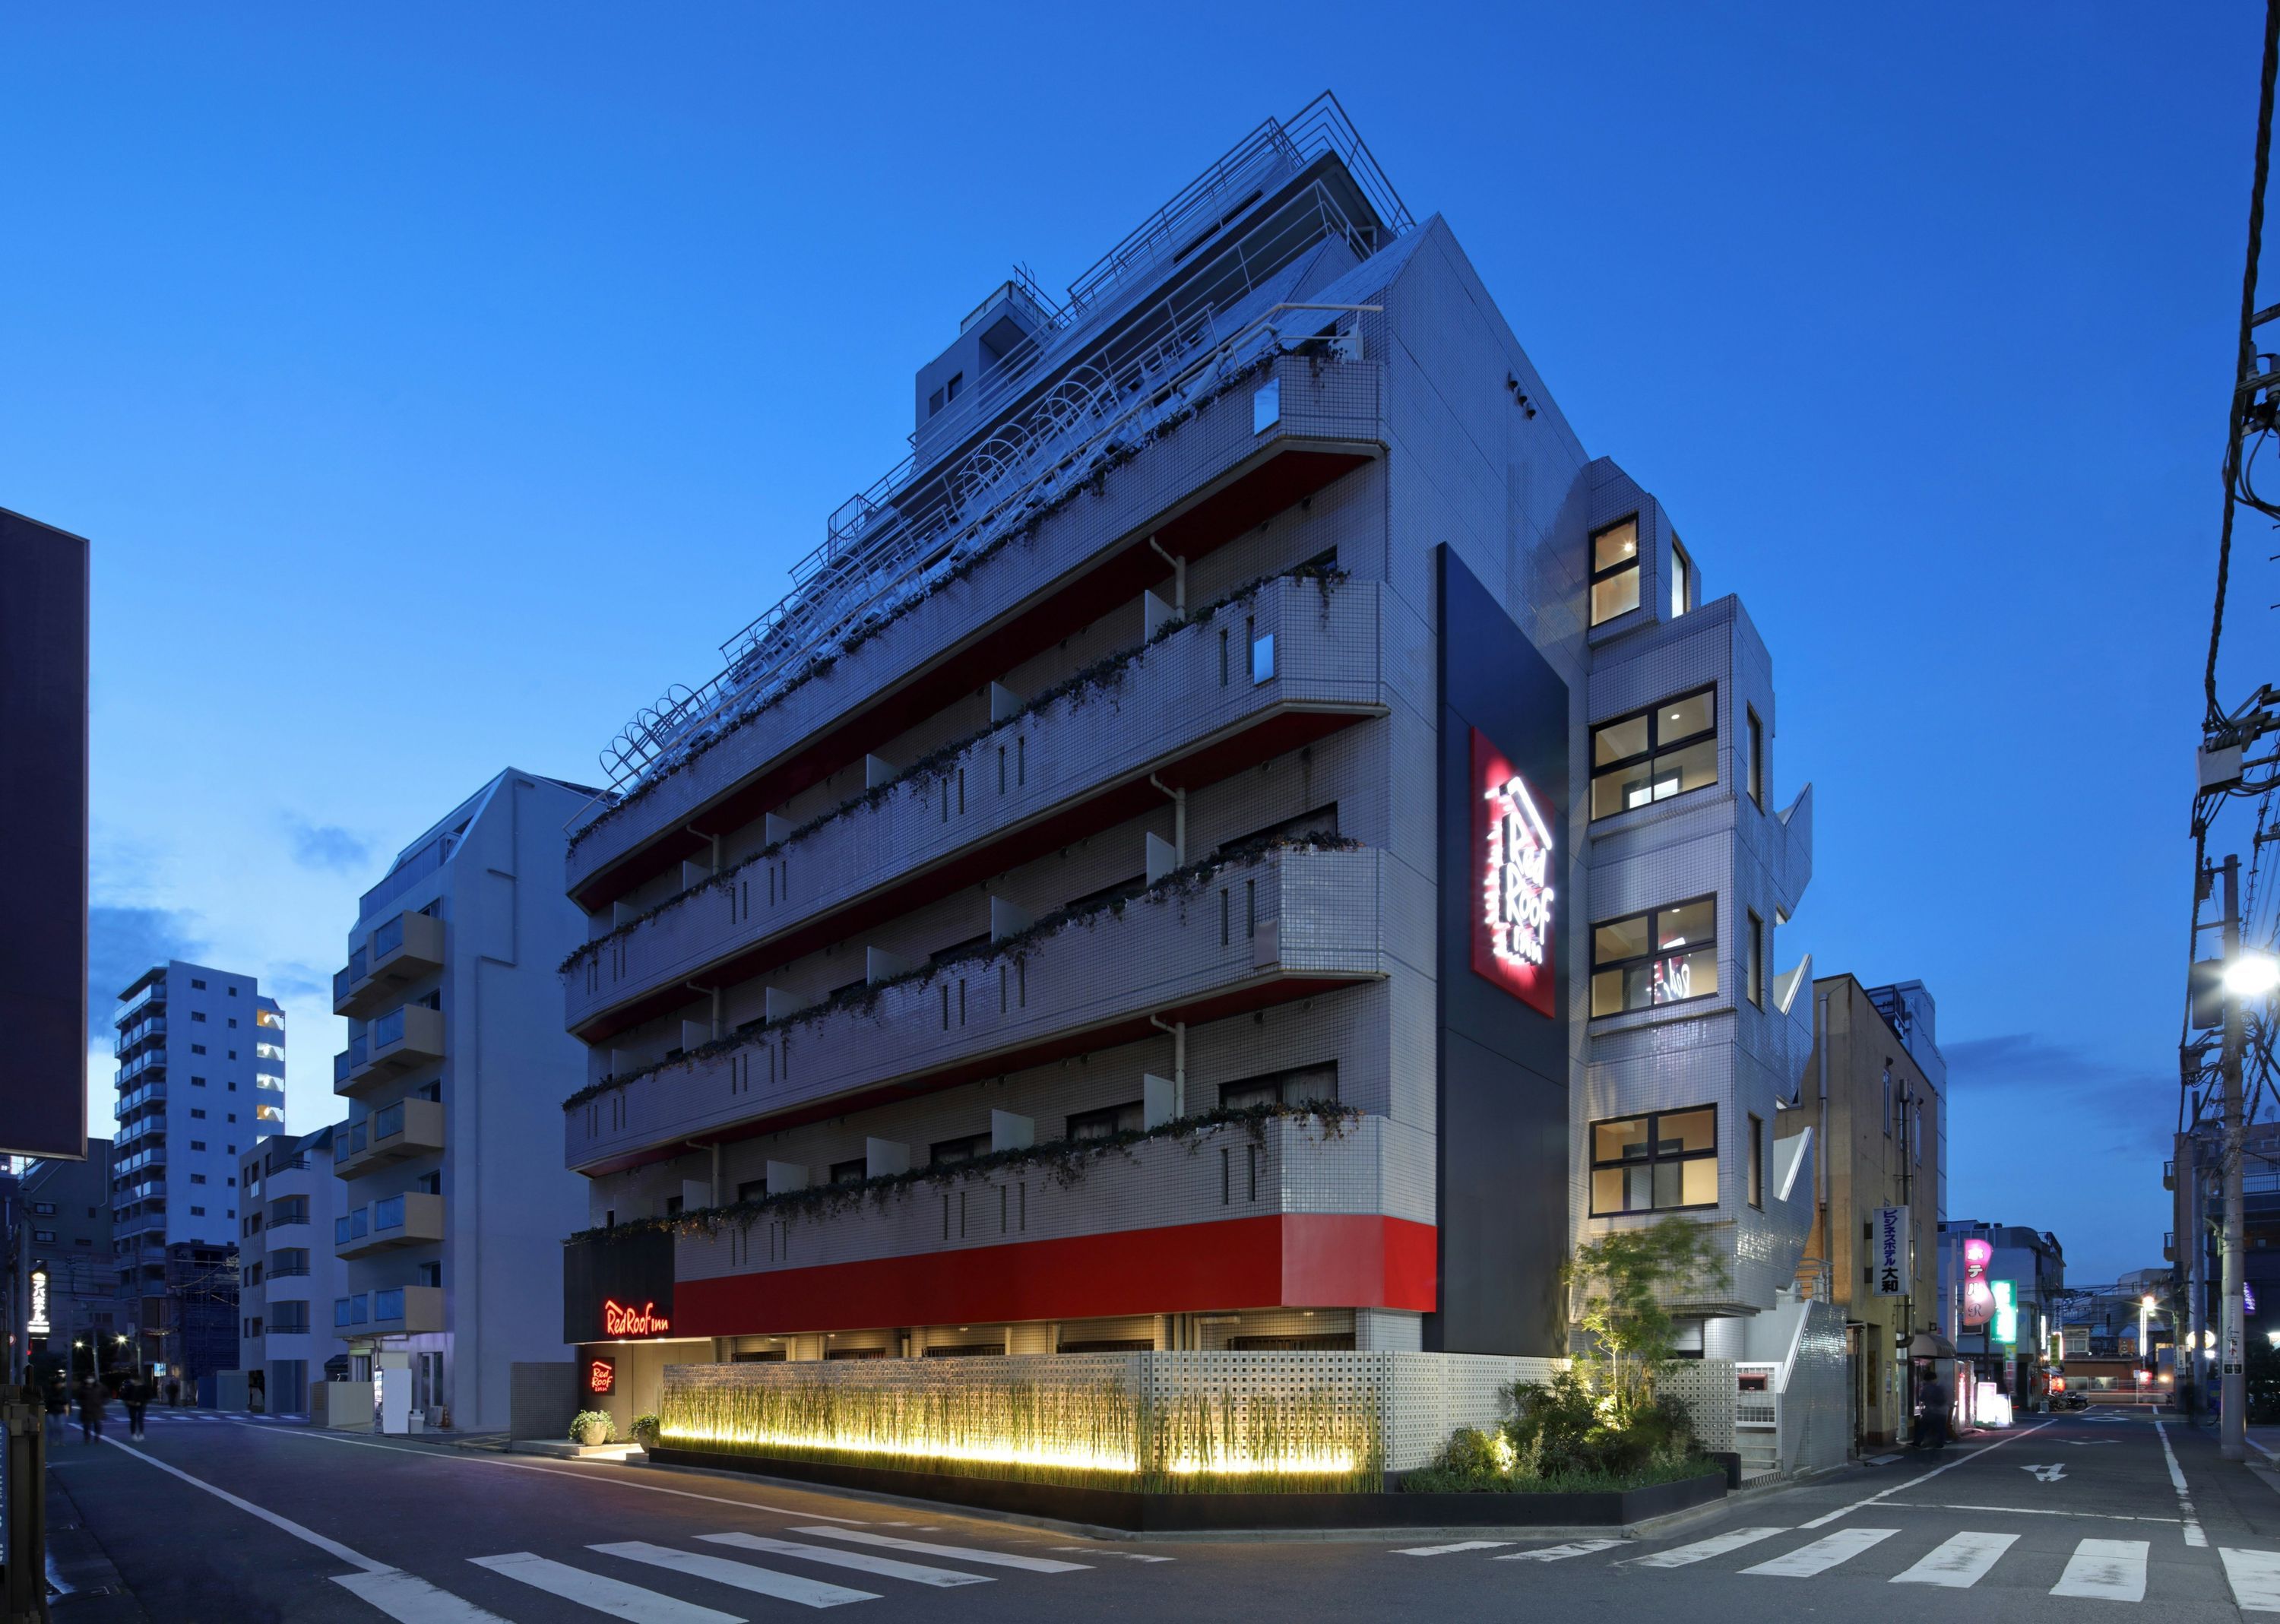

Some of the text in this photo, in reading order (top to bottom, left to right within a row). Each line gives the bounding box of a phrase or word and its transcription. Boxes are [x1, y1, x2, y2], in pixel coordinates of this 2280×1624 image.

[1509, 812, 1547, 888] Red
[1506, 862, 1554, 945] Roof
[33, 1281, 46, 1322] アパホテル
[591, 1376, 613, 1388] Roof
[593, 1368, 609, 1379] Red
